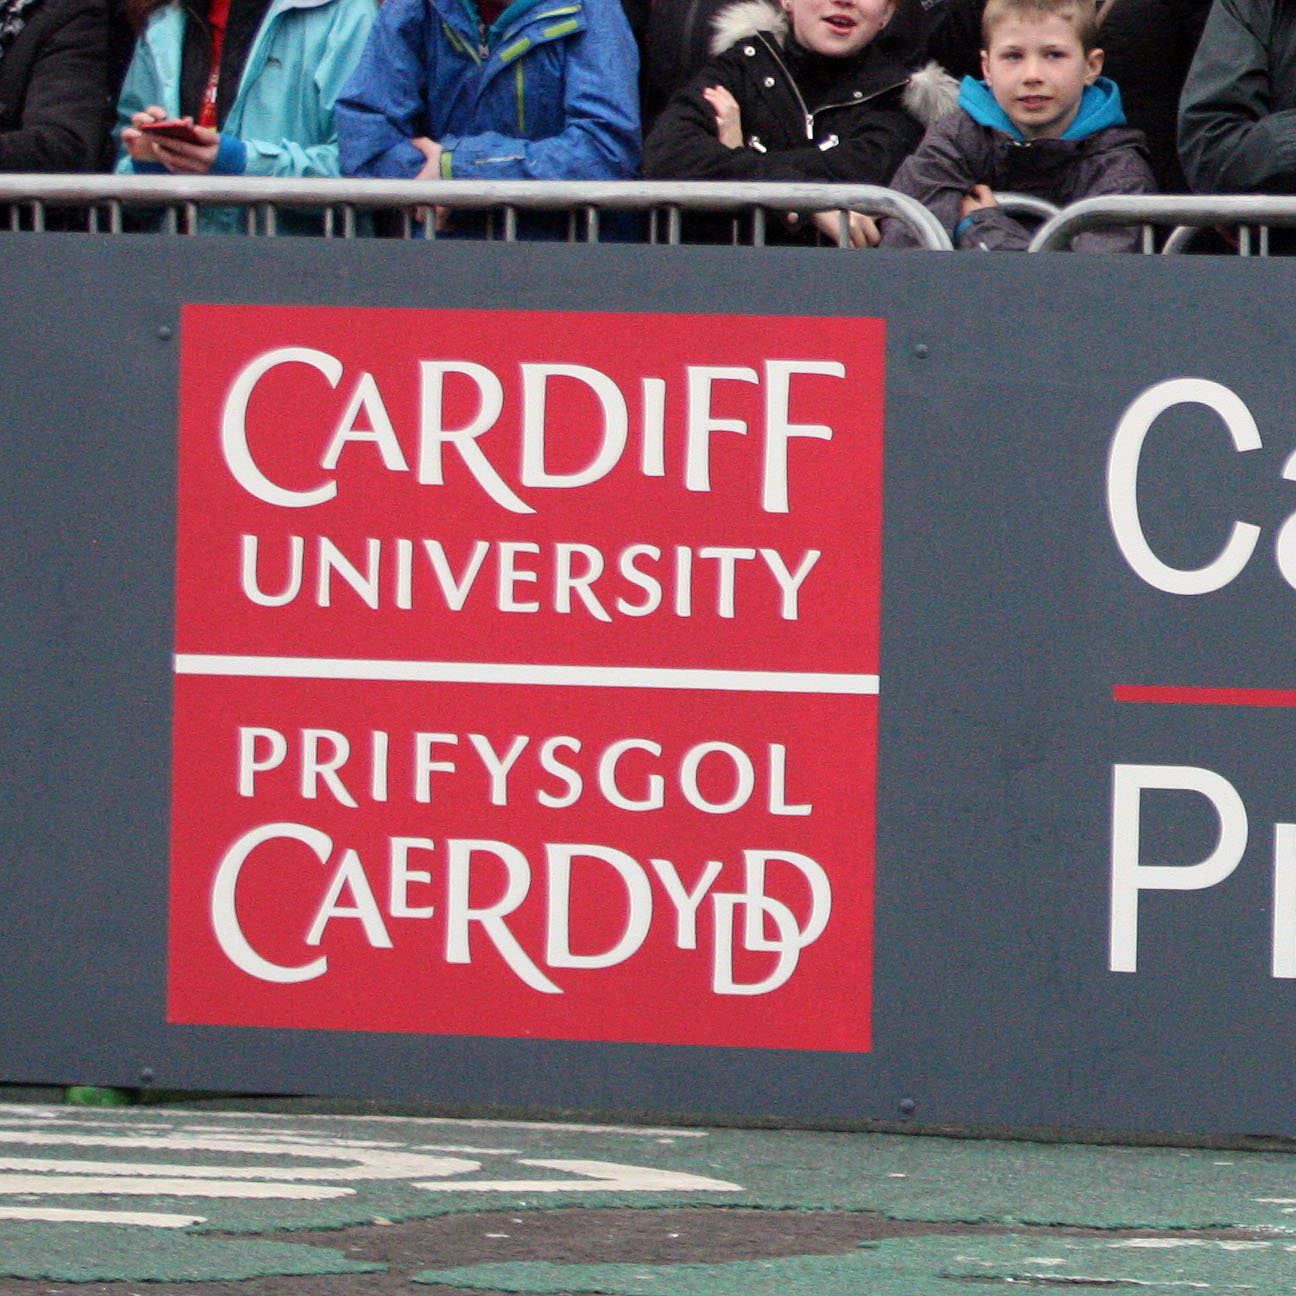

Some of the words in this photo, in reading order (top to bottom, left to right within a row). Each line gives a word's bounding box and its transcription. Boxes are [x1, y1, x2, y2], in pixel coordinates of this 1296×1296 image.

[217, 345, 846, 514] CARDIFF
[239, 534, 822, 623] UNIVERSITY
[236, 726, 813, 816] PRIFYSGOL
[210, 821, 833, 997] CAERDYDD
